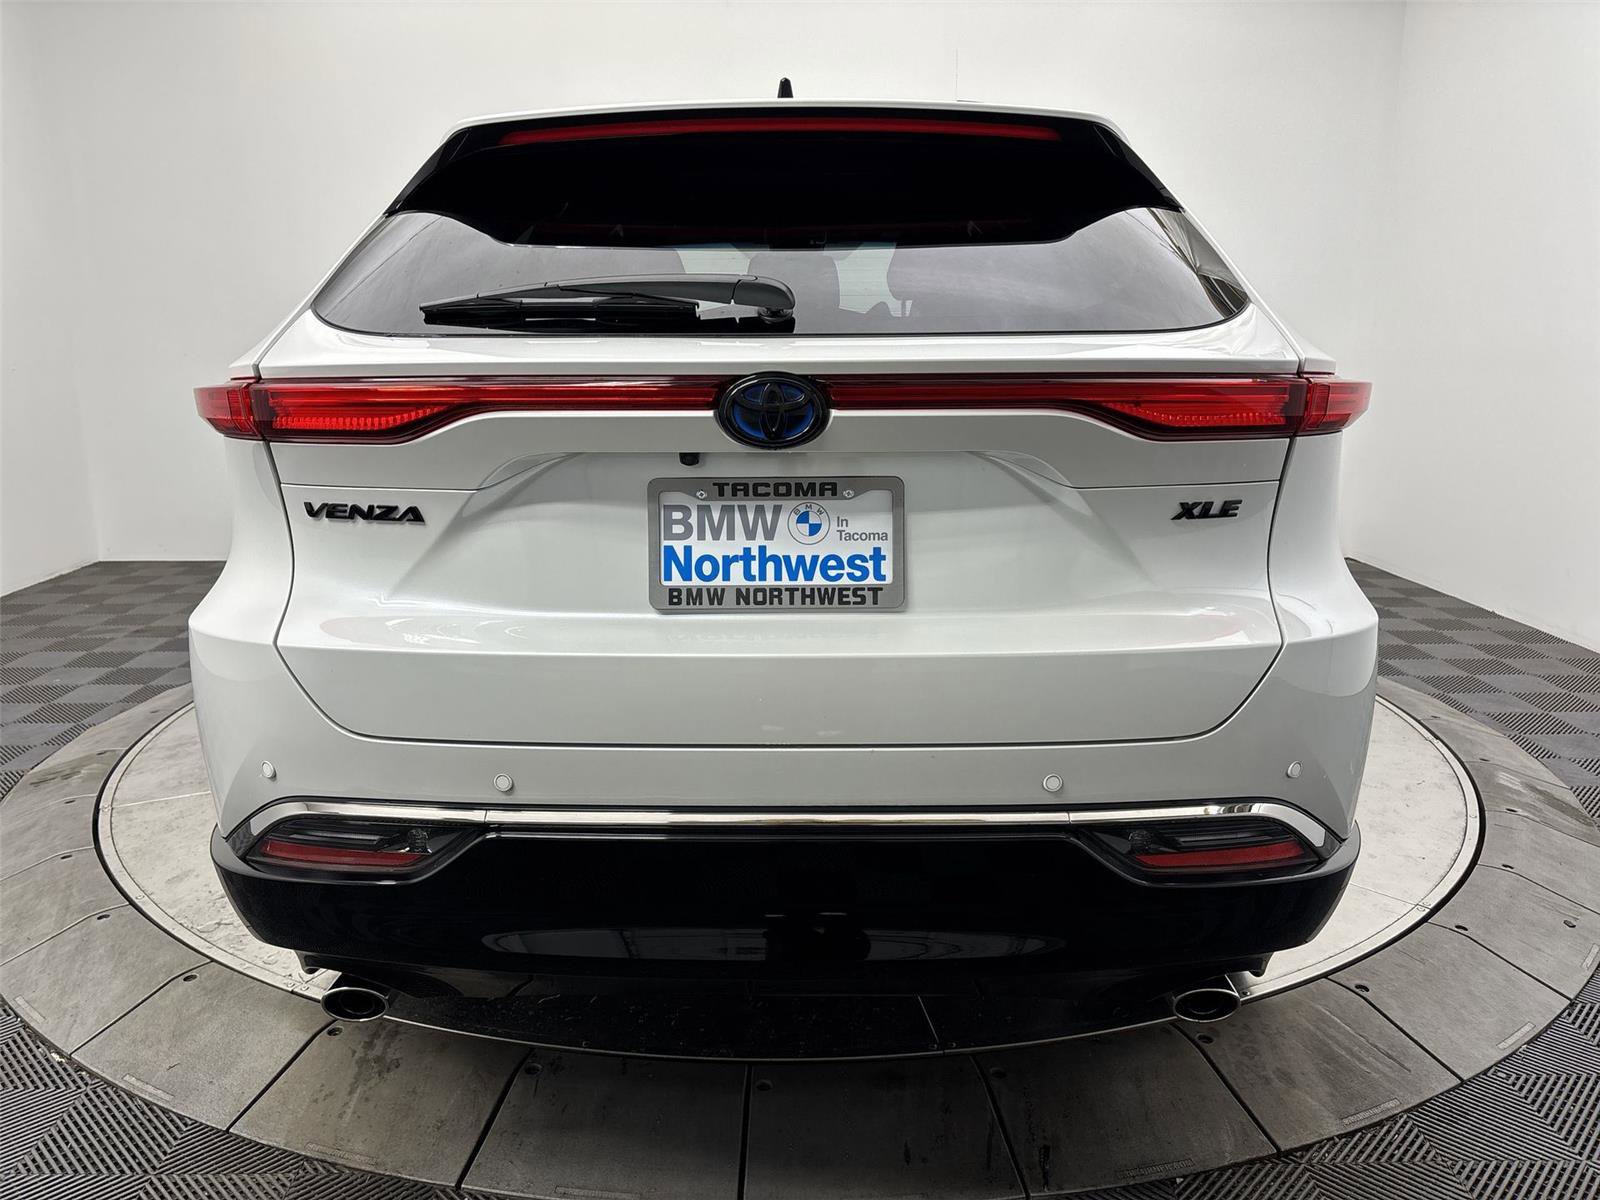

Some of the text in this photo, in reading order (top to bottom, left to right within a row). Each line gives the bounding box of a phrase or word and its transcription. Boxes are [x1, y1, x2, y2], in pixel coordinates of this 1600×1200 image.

[712, 481, 838, 498] TACOMA
[303, 501, 425, 523] VENZA
[1170, 499, 1242, 520] XLE
[662, 504, 783, 541] BMW
[836, 516, 849, 528] In
[836, 530, 889, 542] Tacoma
[663, 545, 886, 583] Northwest
[668, 587, 884, 606] BMW NORTHWEST
